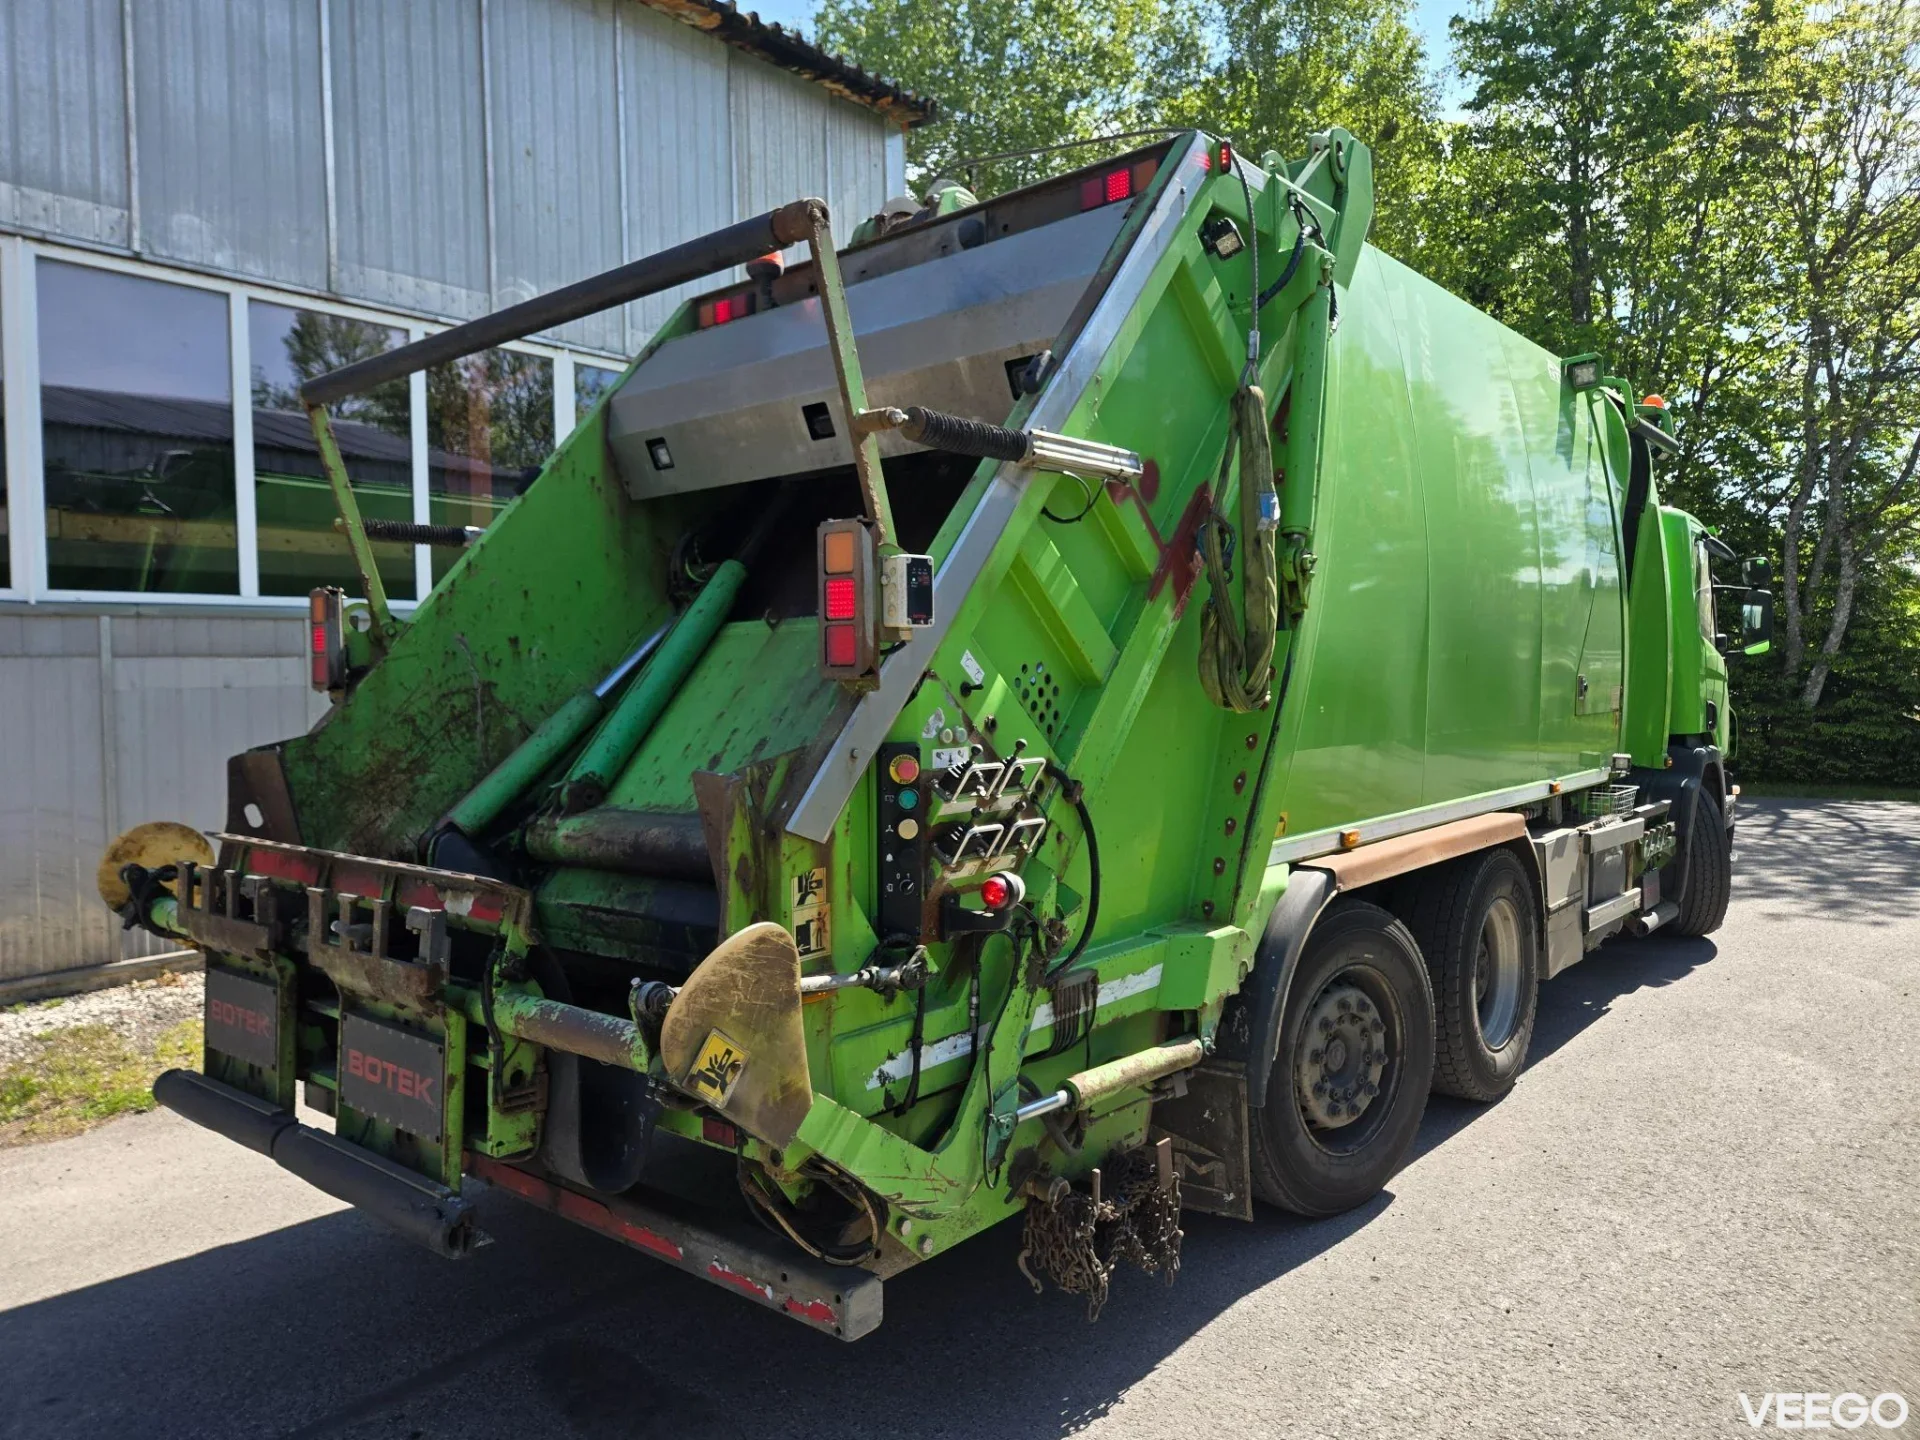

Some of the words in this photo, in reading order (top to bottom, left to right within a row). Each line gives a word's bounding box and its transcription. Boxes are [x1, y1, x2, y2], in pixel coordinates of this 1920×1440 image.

[896, 872, 901, 880] 0
[211, 1000, 271, 1038] BOTEK
[348, 1049, 436, 1106] BOTEK
